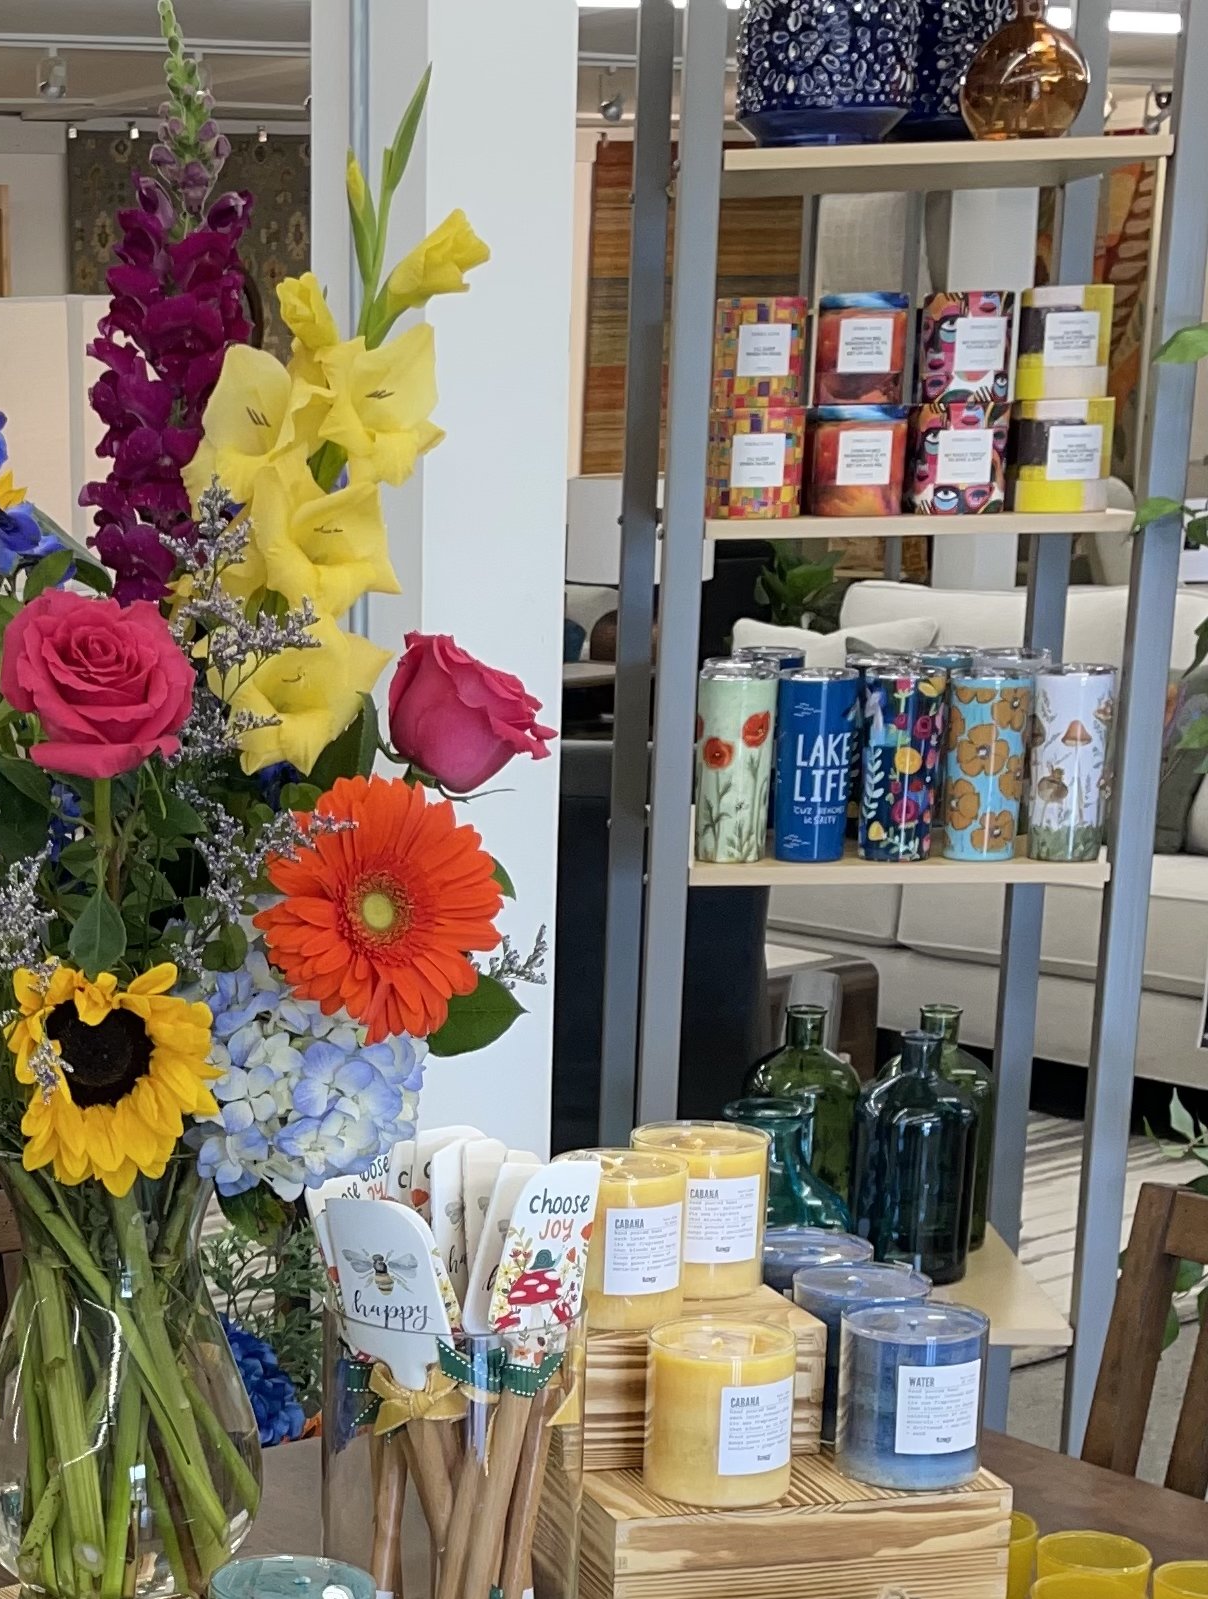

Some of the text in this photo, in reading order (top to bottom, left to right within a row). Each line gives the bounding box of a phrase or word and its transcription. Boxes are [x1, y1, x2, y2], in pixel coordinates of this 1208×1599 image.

[796, 732, 851, 767] LAKE
[794, 768, 848, 802] LIFE
[359, 1156, 389, 1182] oose
[529, 1188, 590, 1214] choose
[690, 1189, 719, 1199] CABANA
[615, 1219, 644, 1229] CABANA
[352, 1290, 435, 1331] happy
[909, 1377, 935, 1387] WATER
[730, 1397, 759, 1408] CABANA
